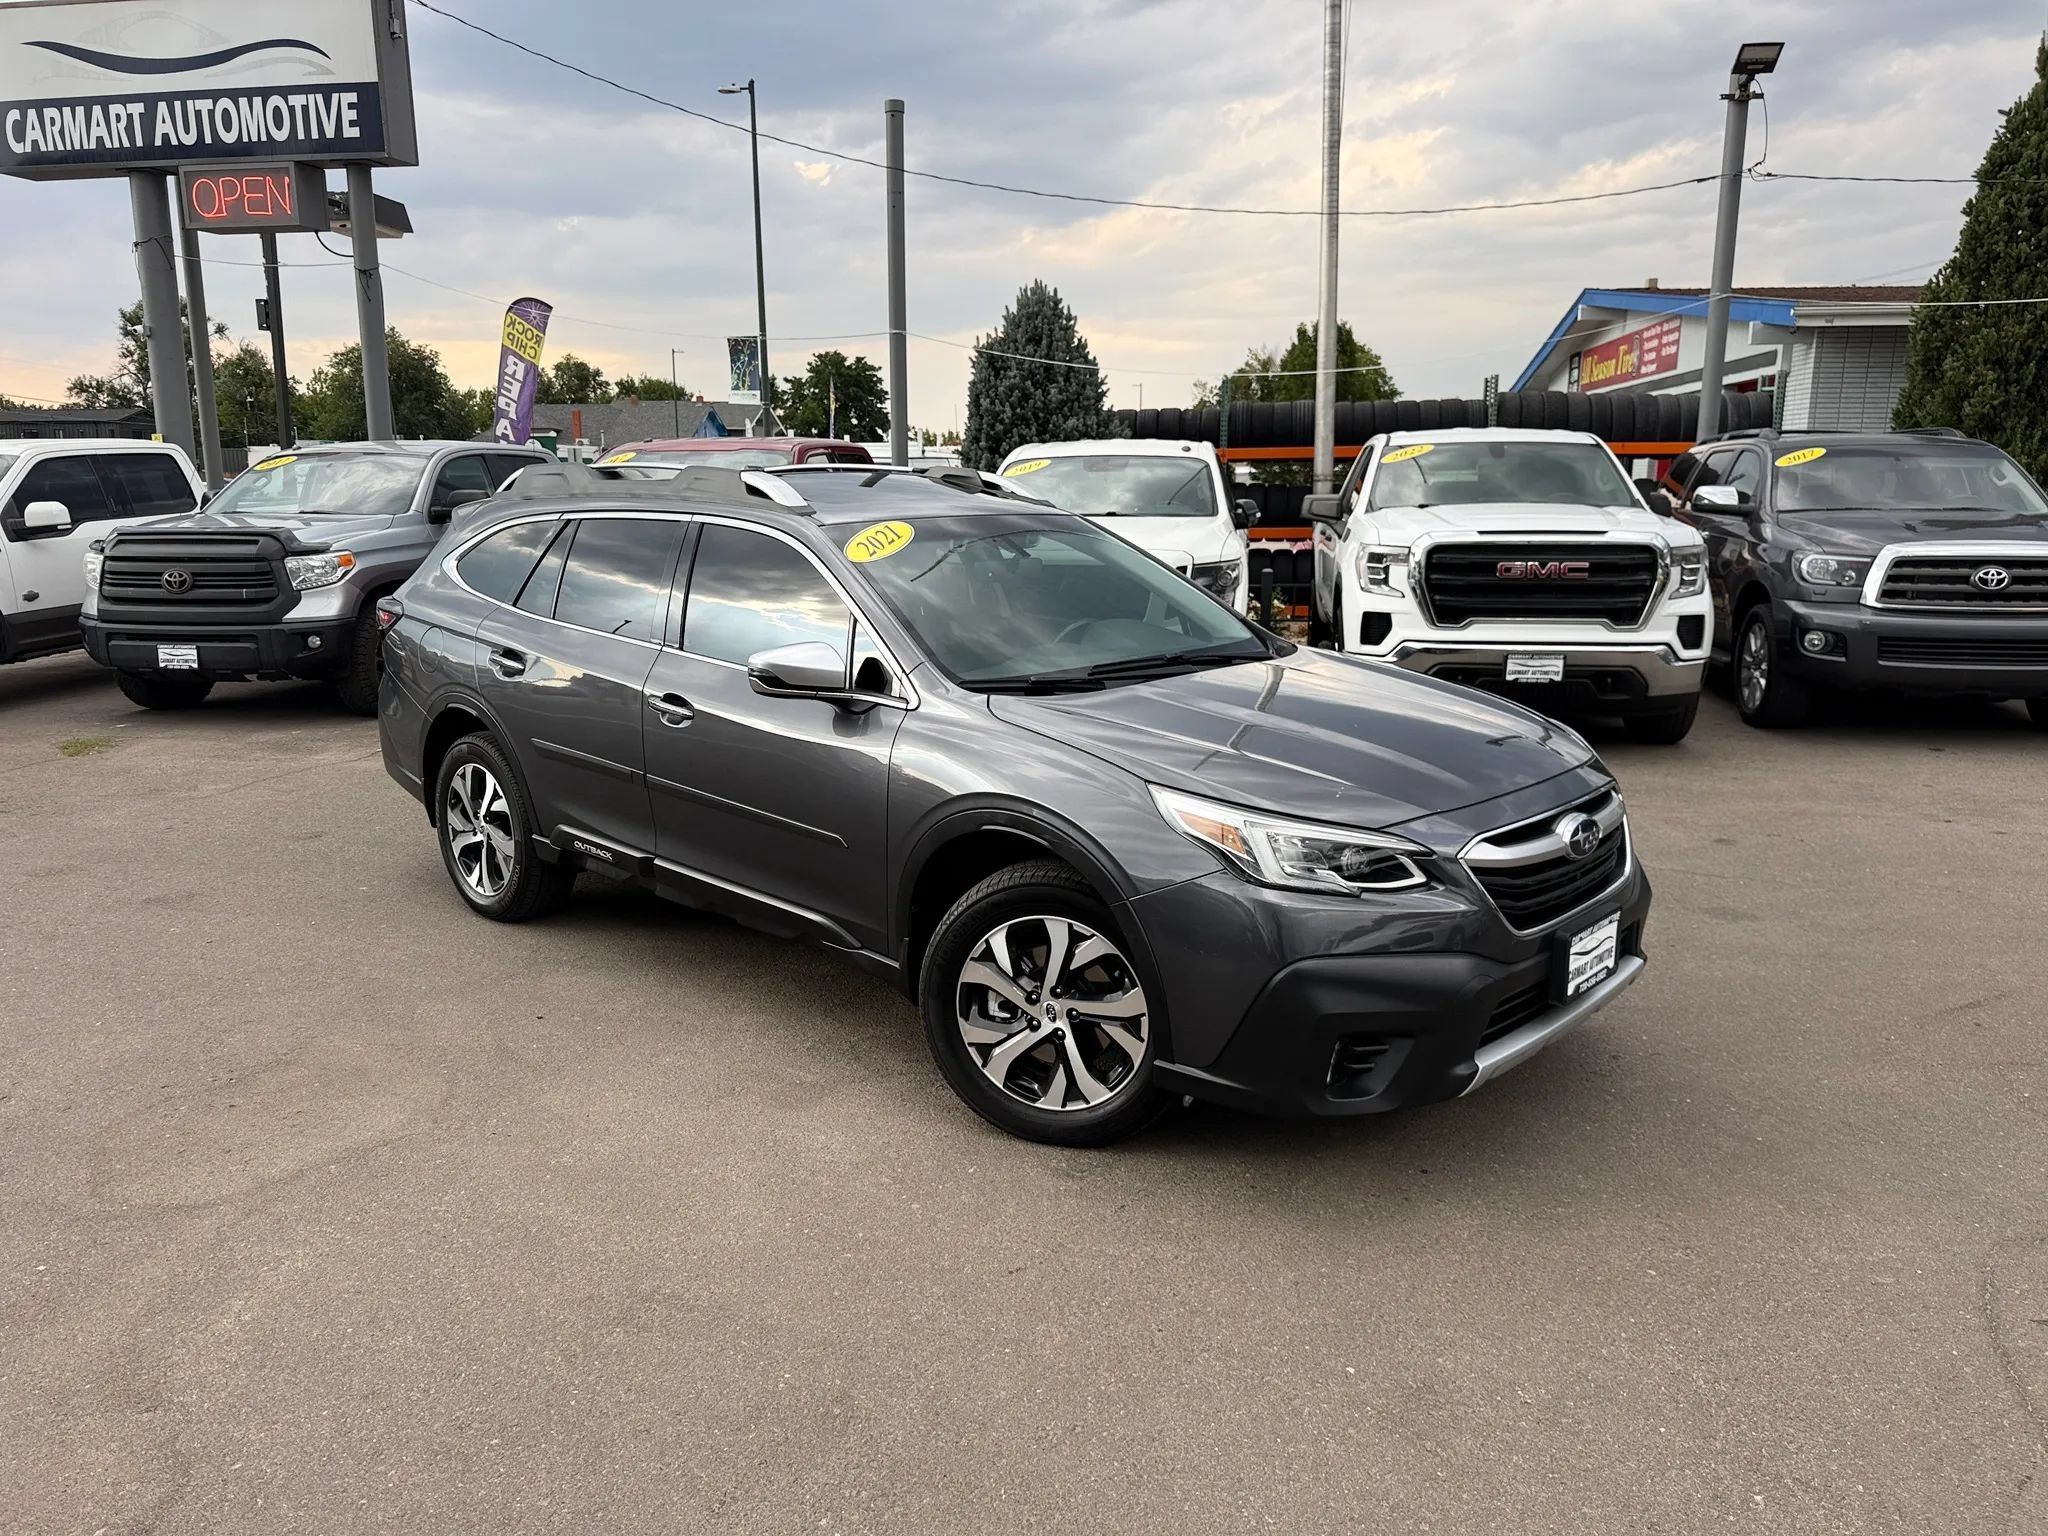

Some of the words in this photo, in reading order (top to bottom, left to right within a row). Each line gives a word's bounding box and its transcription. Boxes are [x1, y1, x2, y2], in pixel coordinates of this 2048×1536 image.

[5, 102, 145, 154] CARMART
[154, 92, 361, 147] AUTOMOTIVE
[192, 175, 291, 220] OPEN
[1786, 449, 1815, 464] 2017
[856, 524, 903, 558] 2021
[1496, 561, 1590, 579] GMC
[573, 840, 613, 861] OUTBACK
[1568, 960, 1589, 982] CARMART
[1589, 946, 1613, 972] AUTOMOTIVE
